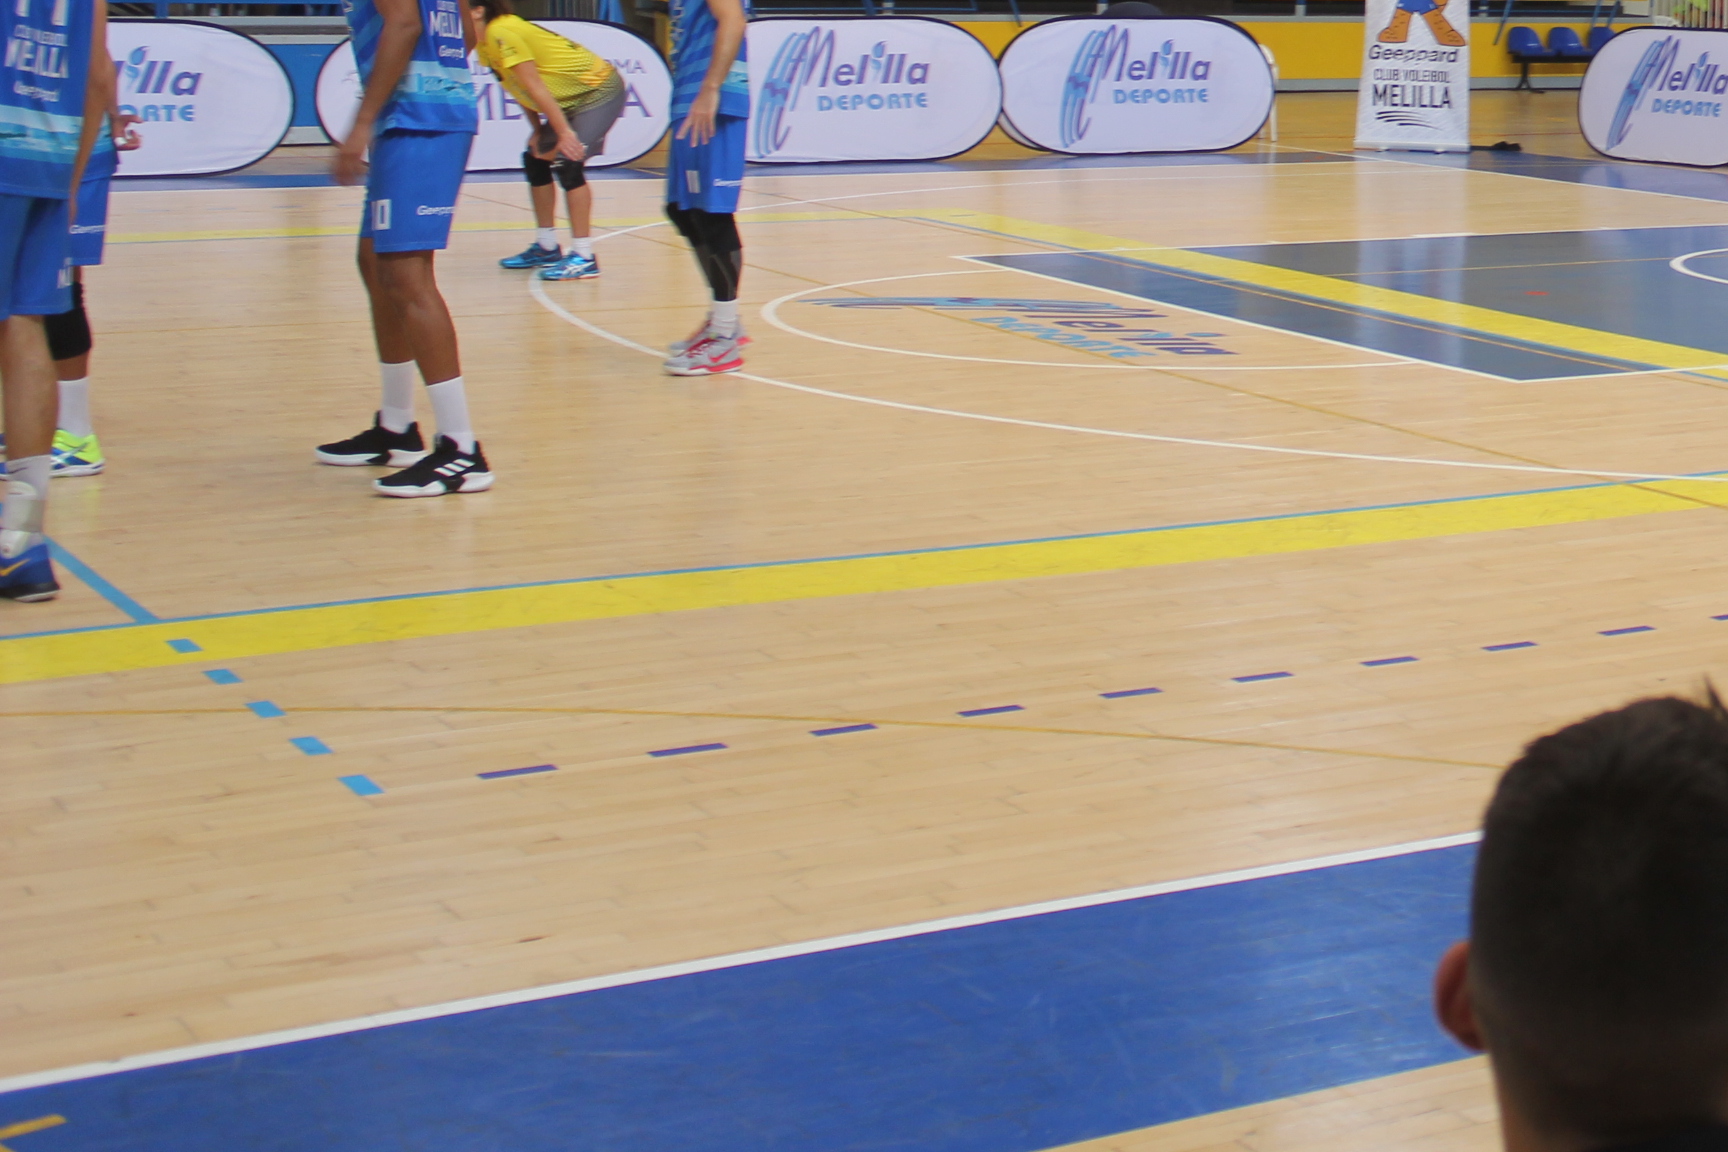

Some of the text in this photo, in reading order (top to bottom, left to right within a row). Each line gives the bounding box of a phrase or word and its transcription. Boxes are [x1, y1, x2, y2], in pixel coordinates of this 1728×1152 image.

[1368, 44, 1460, 65] Geeppard
[1373, 68, 1451, 84] CLUB VOLEIBOL
[816, 92, 929, 112] DEPORTE
[1112, 88, 1209, 104] DEPORTE
[1371, 83, 1453, 109] MELILLA
[118, 104, 196, 122] ORTE
[1651, 98, 1723, 118] DEPORTE
